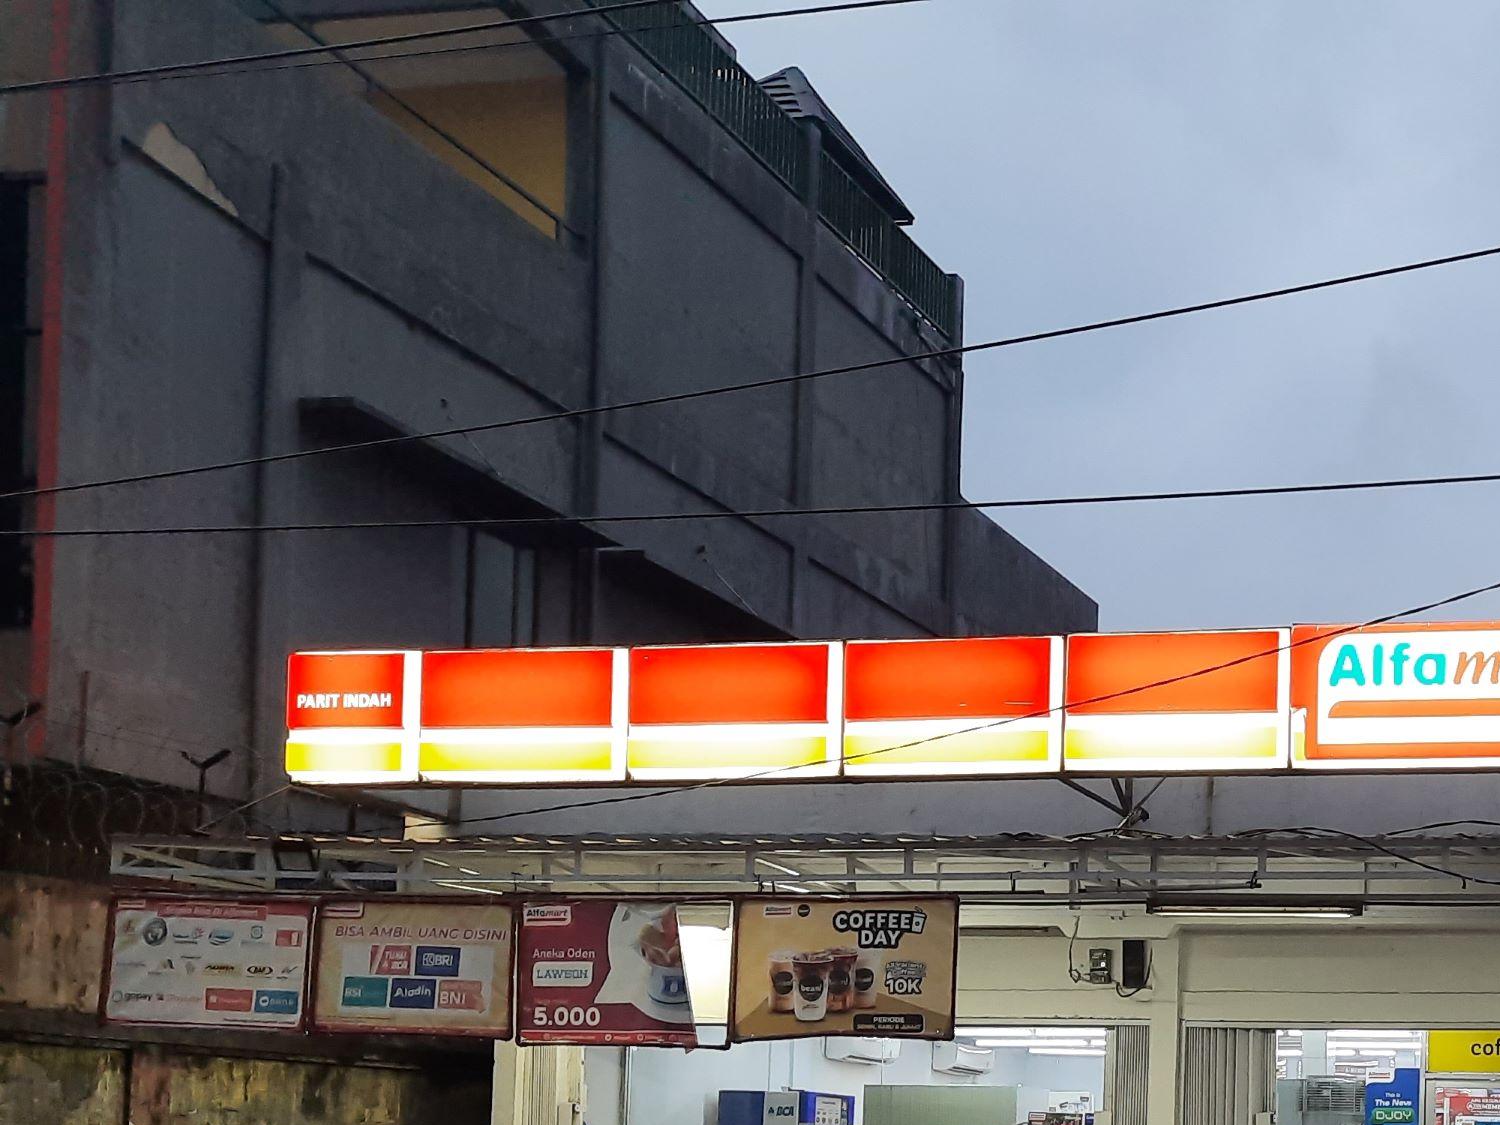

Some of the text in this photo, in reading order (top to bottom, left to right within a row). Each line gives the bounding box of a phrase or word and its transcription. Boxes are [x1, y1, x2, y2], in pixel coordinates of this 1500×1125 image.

[297, 693, 391, 708] PARIT INDAH
[526, 909, 567, 917] Alfamart
[835, 913, 911, 929] COFFEE
[335, 926, 506, 940] BISA AMBIL UANG DISINI
[861, 930, 900, 946] DAY
[533, 948, 595, 958] Aneka Oden
[435, 955, 453, 966] BRI
[536, 969, 588, 979] LAWSON
[394, 985, 432, 997] Aladin
[886, 979, 921, 994] 10K
[440, 991, 466, 1005] BNI
[533, 1006, 600, 1026] 5.000
[776, 1106, 794, 1117] BCA
[1375, 1110, 1412, 1120] DJOY
